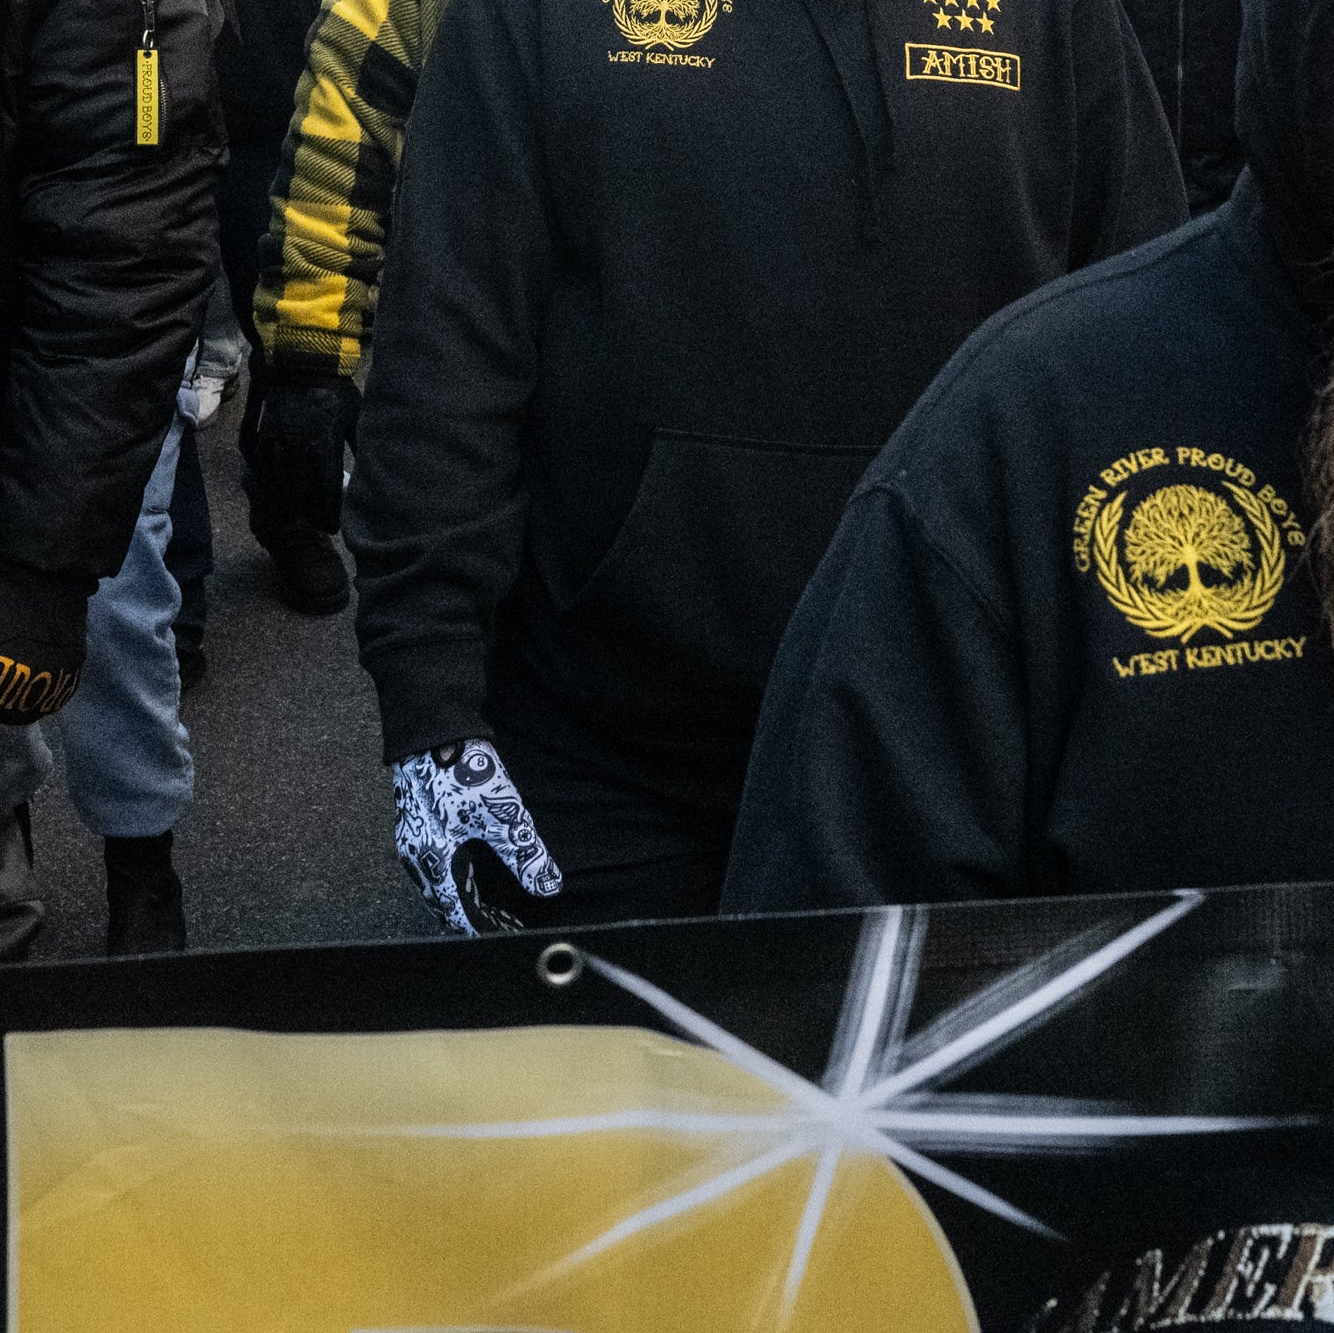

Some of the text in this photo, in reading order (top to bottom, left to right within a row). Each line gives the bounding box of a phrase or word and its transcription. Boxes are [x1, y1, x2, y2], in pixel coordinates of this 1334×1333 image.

[607, 50, 716, 69] WEST KENTUCKY
[921, 50, 1012, 84] AMISH
[141, 63, 153, 139] PROUD BOYS
[1073, 446, 1306, 573] GREEN RIVER PROUD BOYS
[1112, 636, 1307, 678] WEST KENTUCKY
